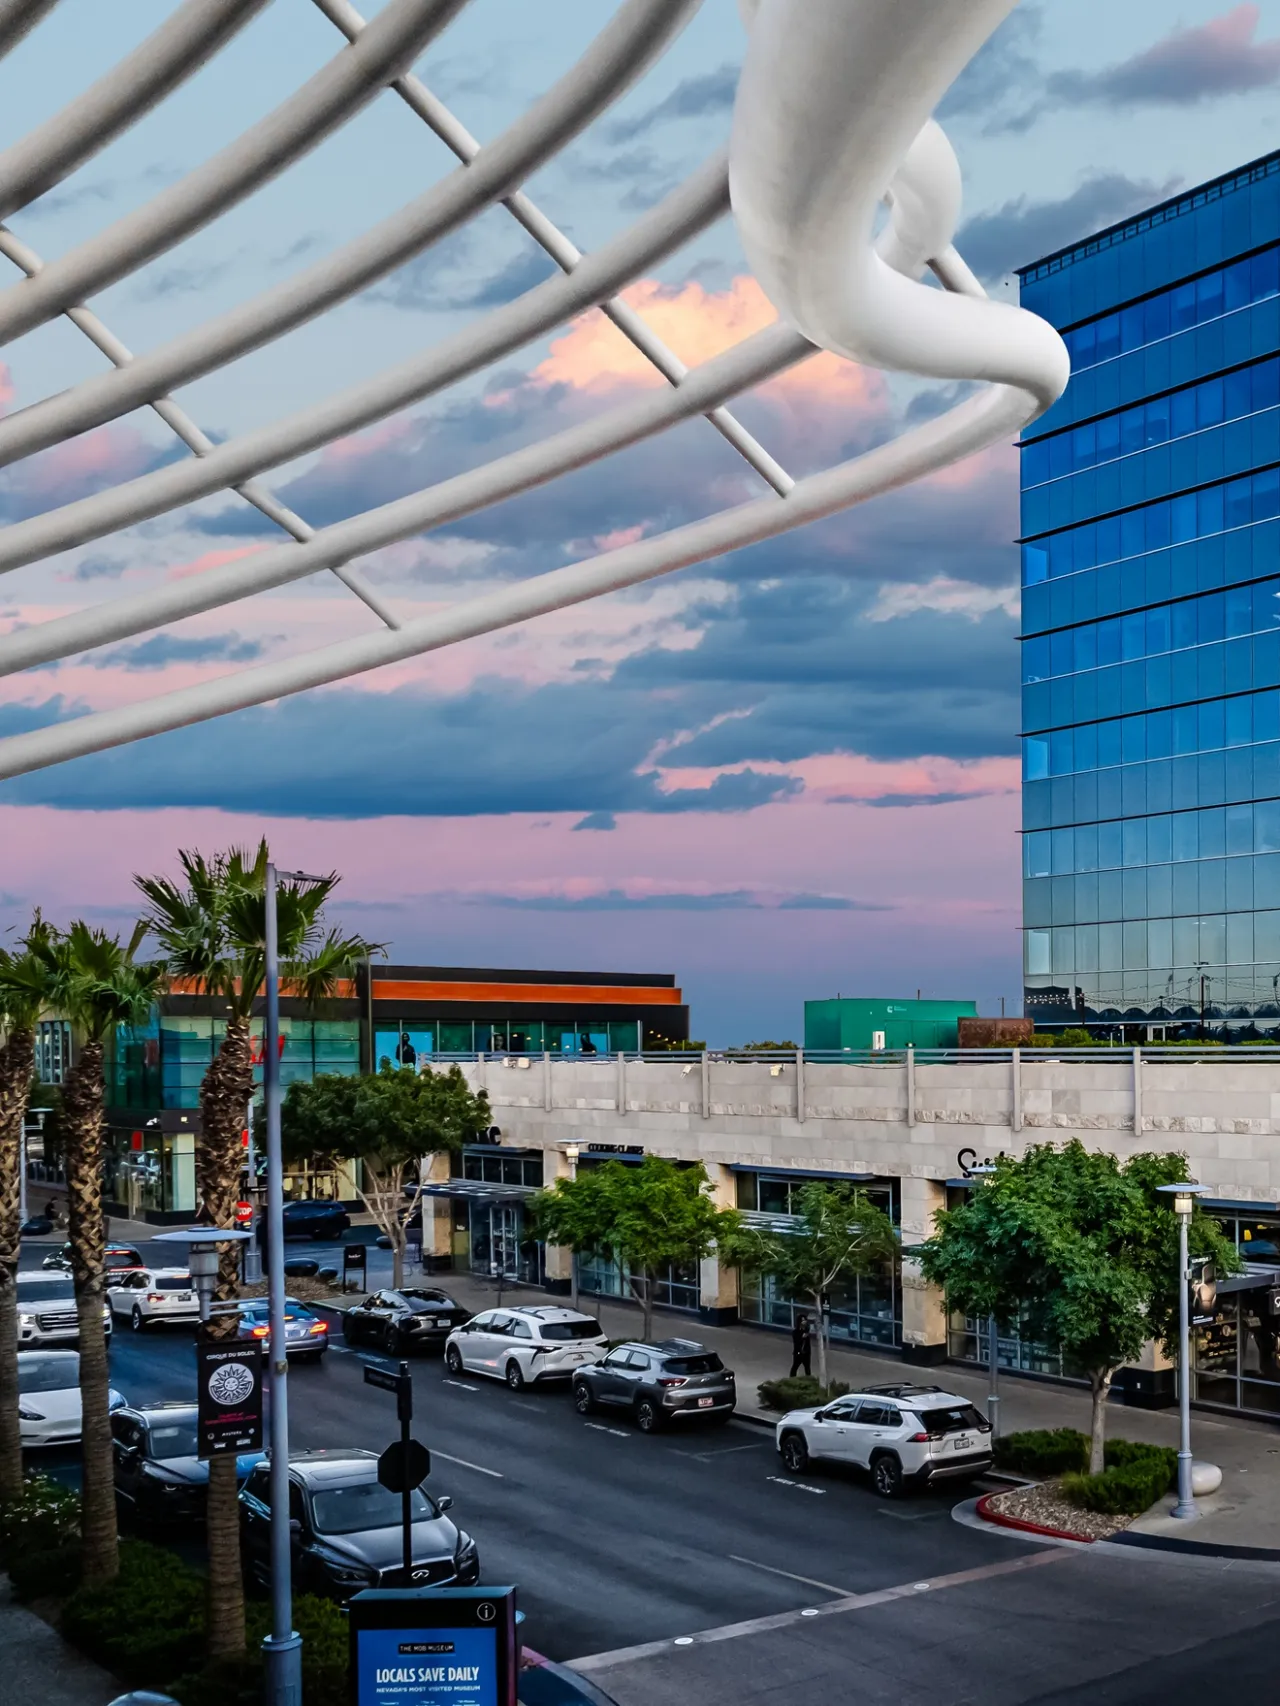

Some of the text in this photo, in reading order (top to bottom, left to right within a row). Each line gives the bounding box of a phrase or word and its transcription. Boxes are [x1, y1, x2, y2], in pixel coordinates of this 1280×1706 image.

[376, 1666, 480, 1683] LOCALS SAVE DAILY
